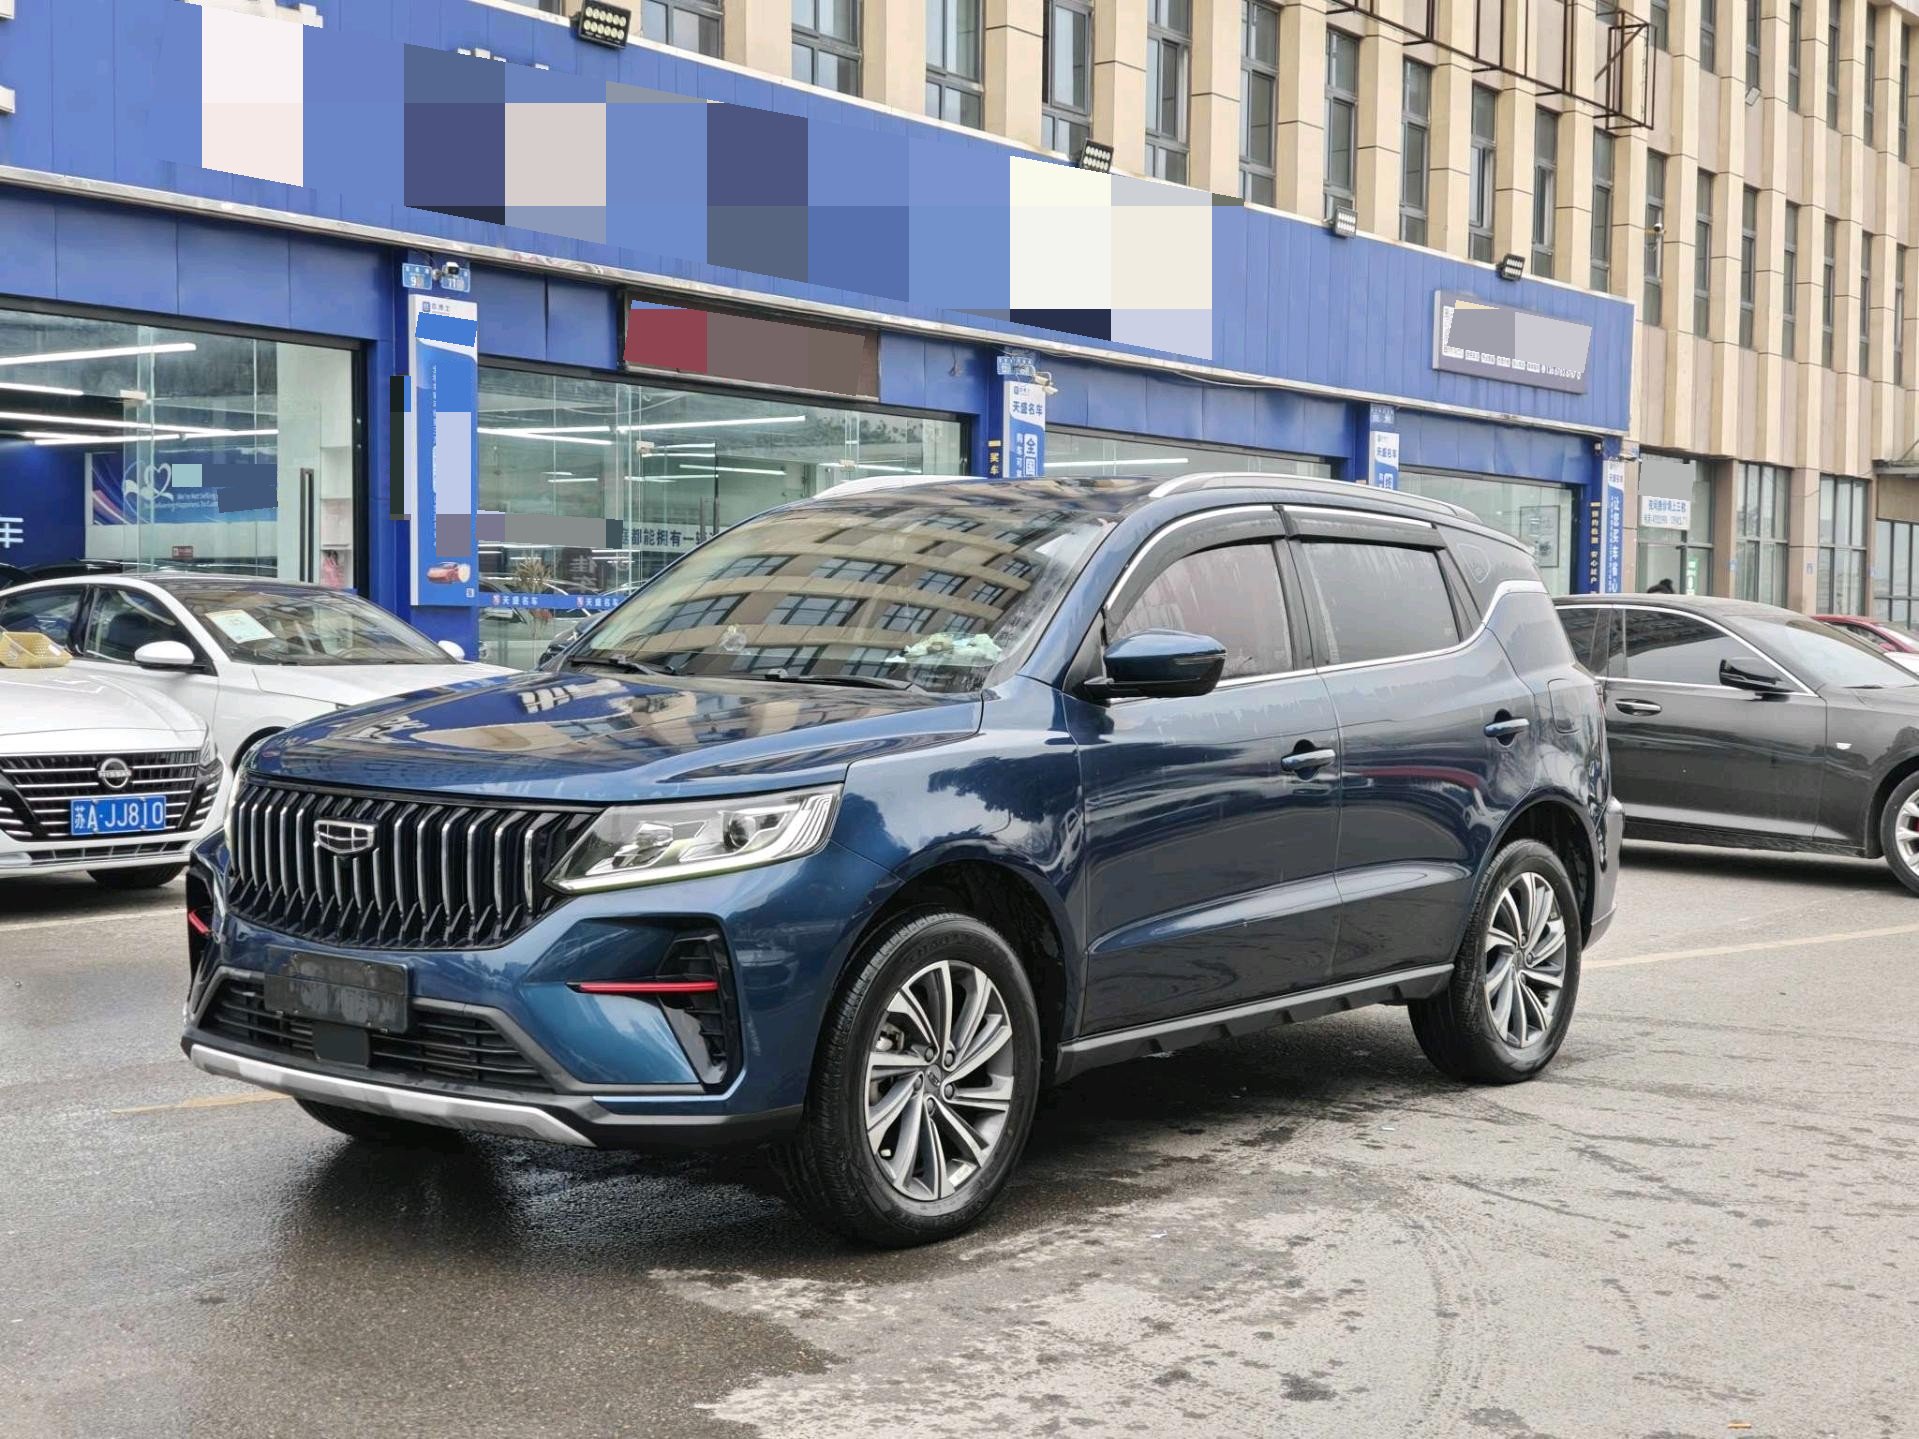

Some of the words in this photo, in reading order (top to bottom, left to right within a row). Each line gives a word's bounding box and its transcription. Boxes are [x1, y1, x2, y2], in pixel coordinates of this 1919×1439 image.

[1012, 400, 1043, 417] 天盛名车
[502, 595, 538, 606] 天盛名车
